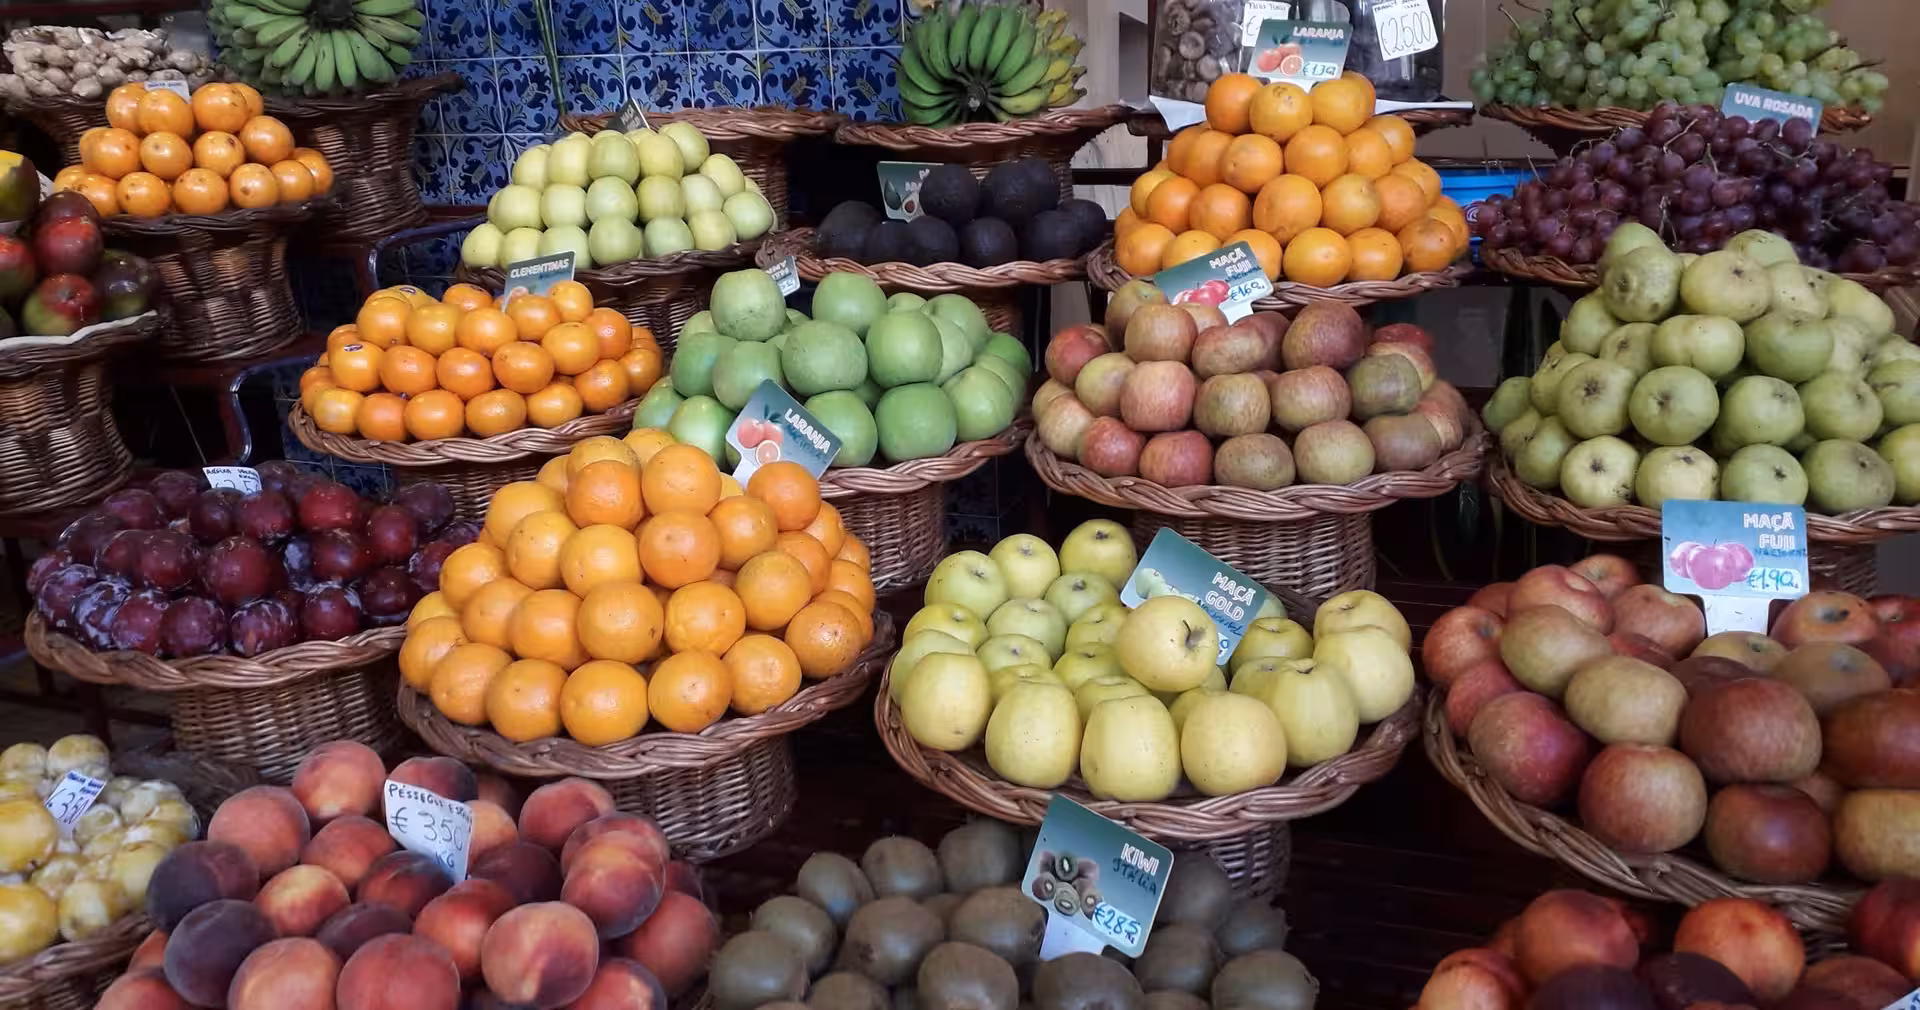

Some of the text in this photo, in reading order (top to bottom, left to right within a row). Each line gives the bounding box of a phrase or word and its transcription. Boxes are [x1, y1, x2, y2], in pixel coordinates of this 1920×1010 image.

[1293, 26, 1344, 40] LARANJA
[1735, 91, 1814, 119] UVA ROSADA
[510, 258, 569, 279] CLEMENTINAS
[784, 408, 831, 454] LARANJA
[1743, 511, 1795, 532] MAÇÃ
[1758, 533, 1795, 550] FUJI
[1212, 571, 1256, 606] MAÇÃ
[1205, 590, 1245, 621] GOLD
[1121, 843, 1160, 876] KIWI
